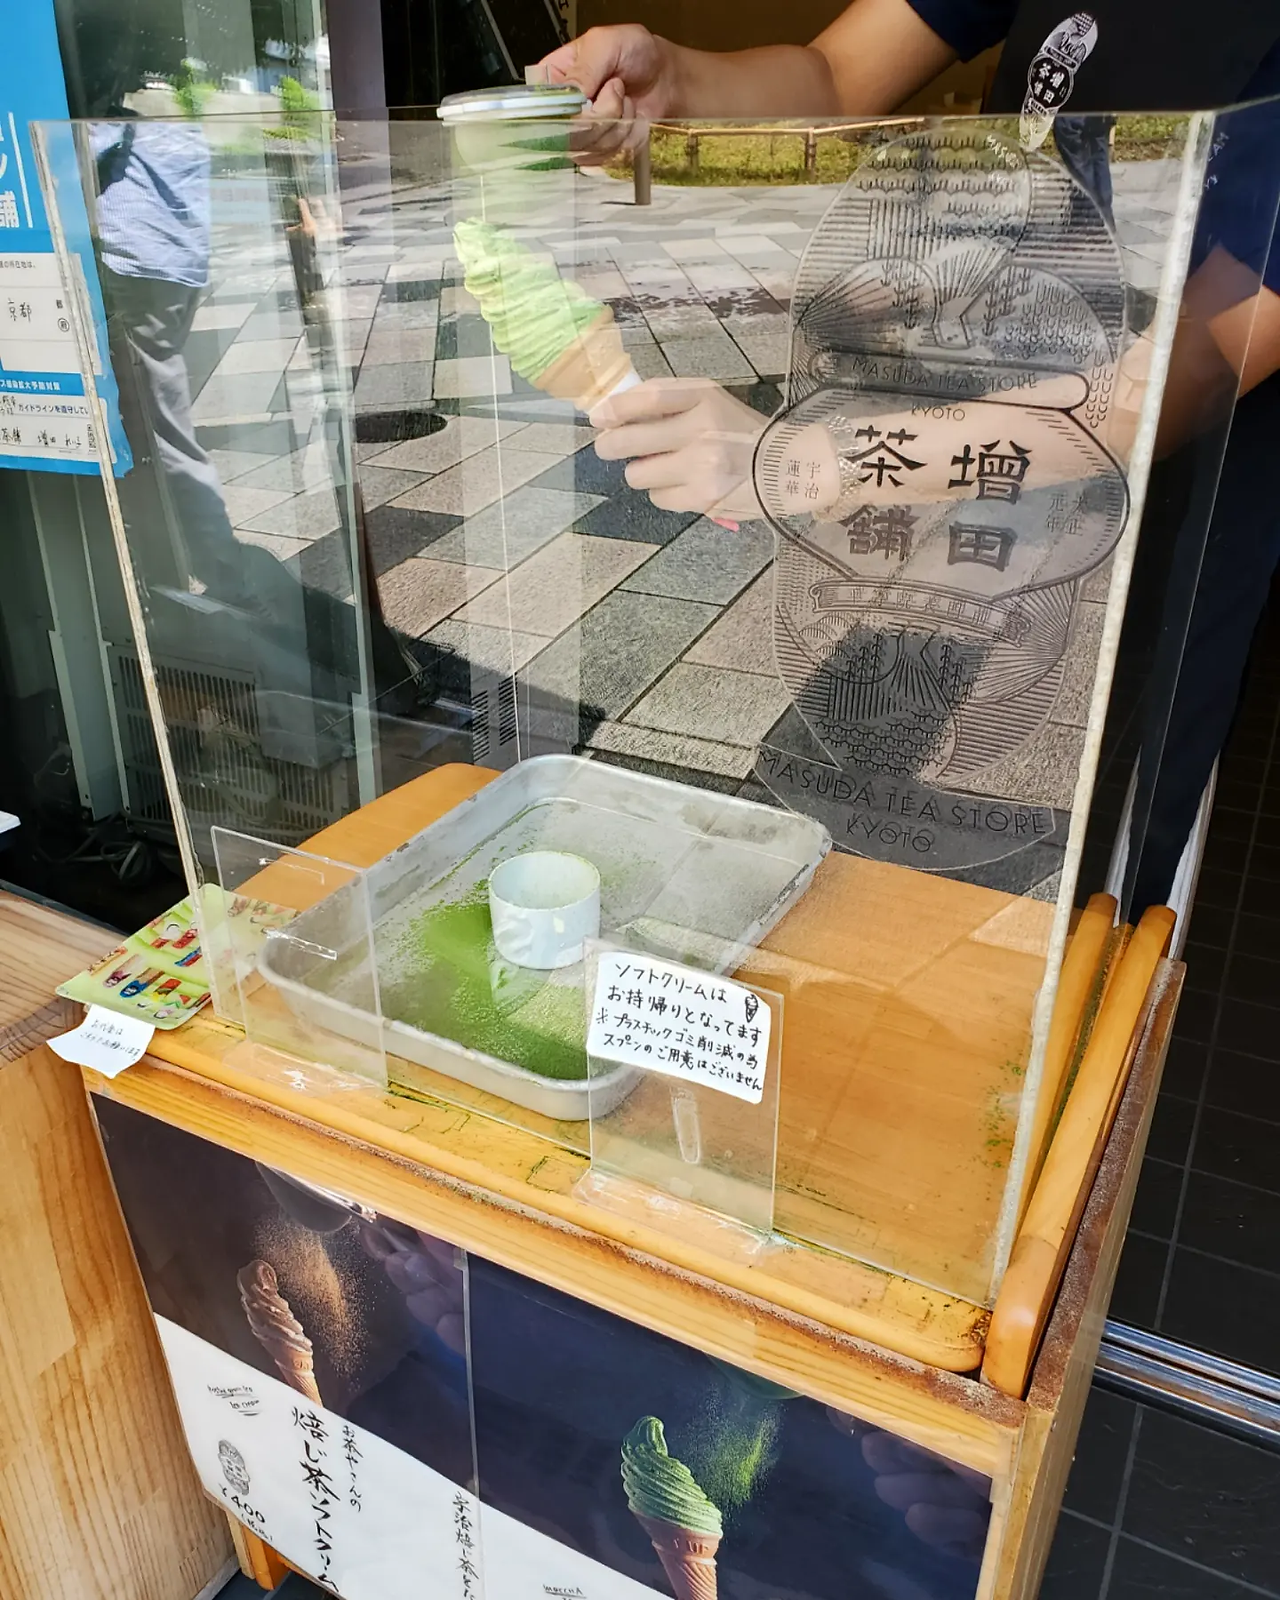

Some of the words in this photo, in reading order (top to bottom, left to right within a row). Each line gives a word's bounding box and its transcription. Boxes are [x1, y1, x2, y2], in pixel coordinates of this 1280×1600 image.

[852, 356, 929, 388] MASUDA
[937, 374, 970, 393] TEA
[979, 372, 1038, 393] STORE
[911, 403, 966, 421] KYOTO
[755, 750, 872, 808] MASUDA
[886, 791, 936, 822] TEA
[951, 804, 1047, 835] STORE
[846, 816, 931, 853] KYOTO
[615, 963, 727, 1003] ソフトクリームは
[607, 985, 763, 1047] お持帰りとなってます
[292, 1406, 342, 1593] 焙じ茶ソフトクリーム
